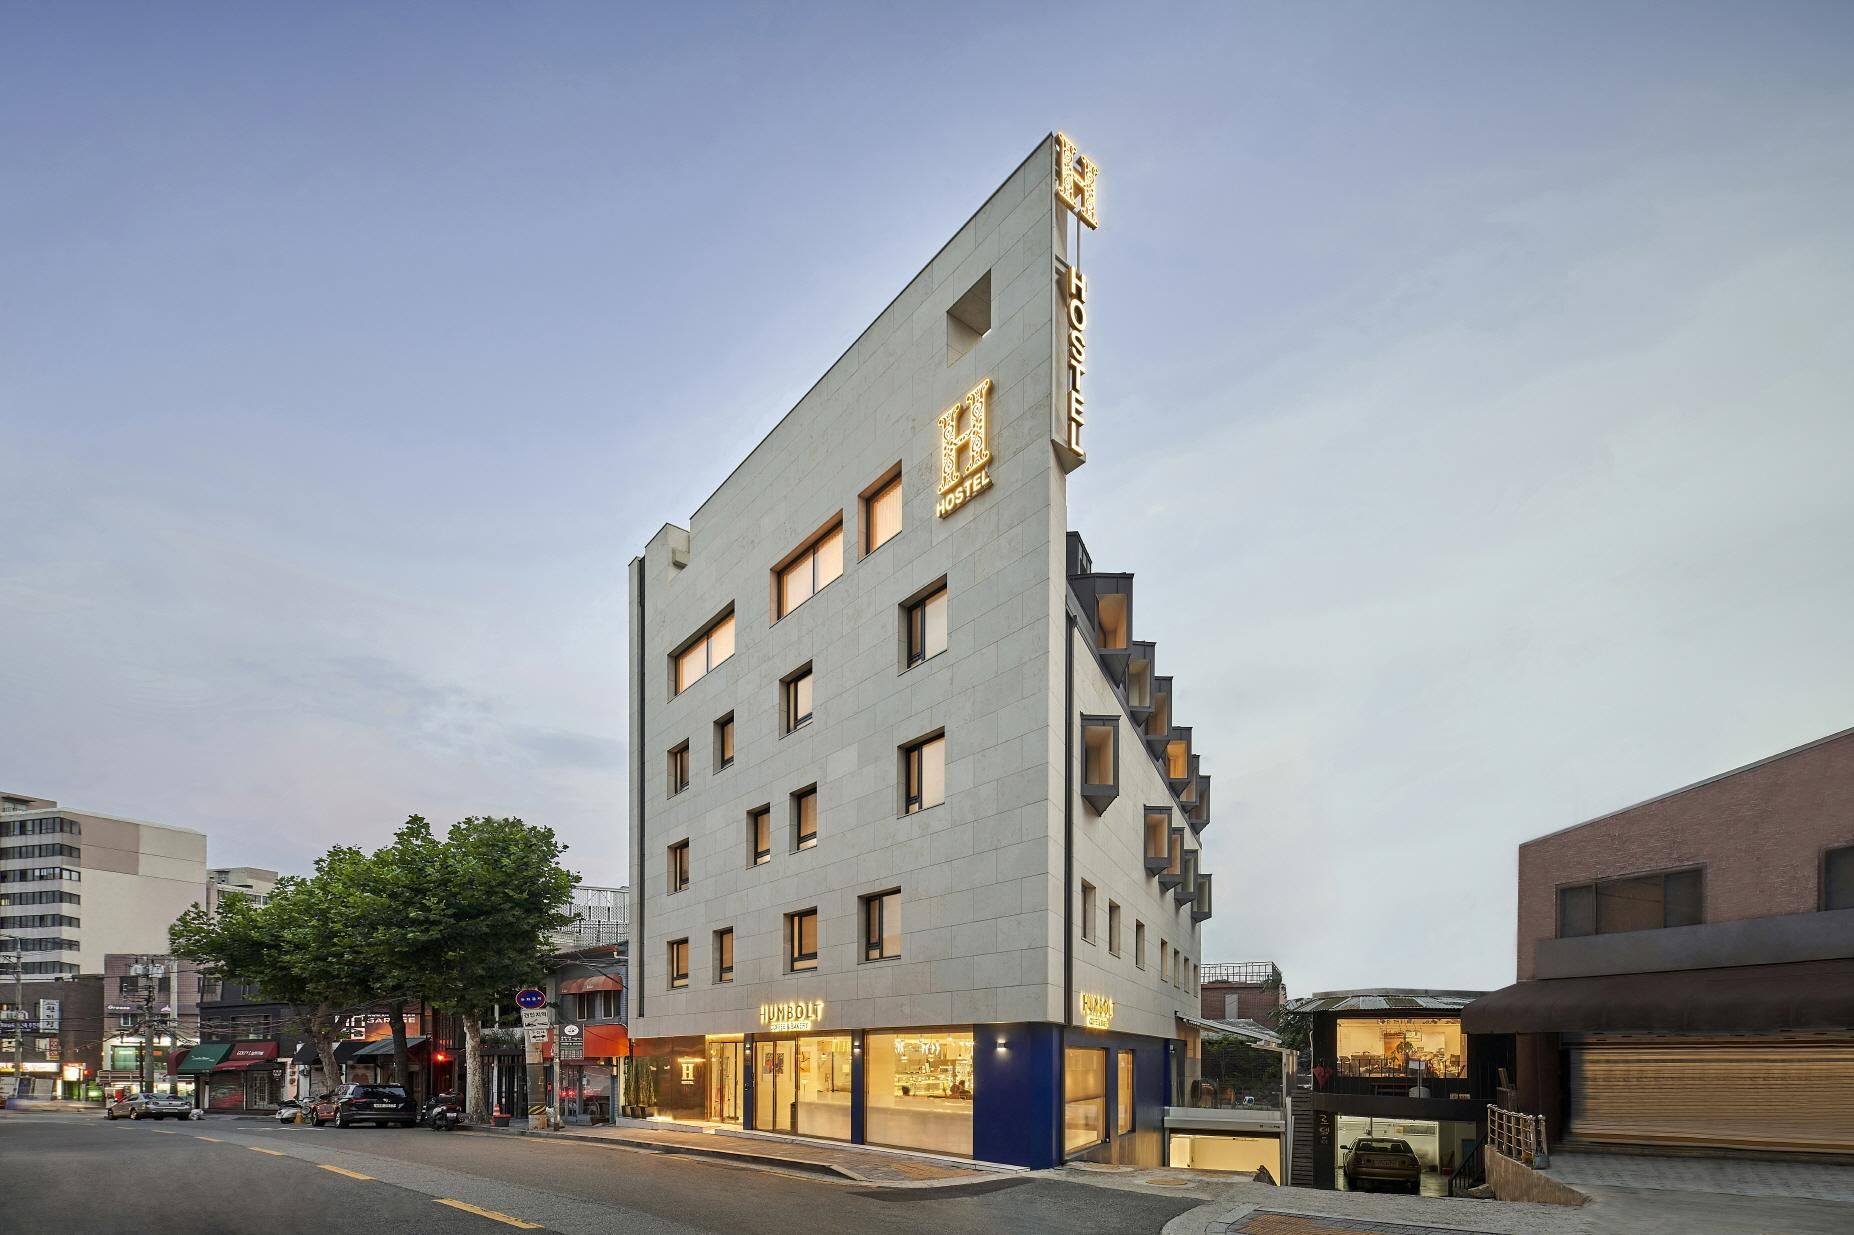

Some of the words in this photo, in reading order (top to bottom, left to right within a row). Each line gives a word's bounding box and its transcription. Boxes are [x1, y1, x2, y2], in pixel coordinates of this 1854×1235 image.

[1056, 131, 1099, 230] H
[1068, 265, 1087, 456] HOSTEL
[937, 378, 992, 495] H
[936, 470, 991, 519] HOSTEL
[760, 1002, 823, 1022] HUMBOLT
